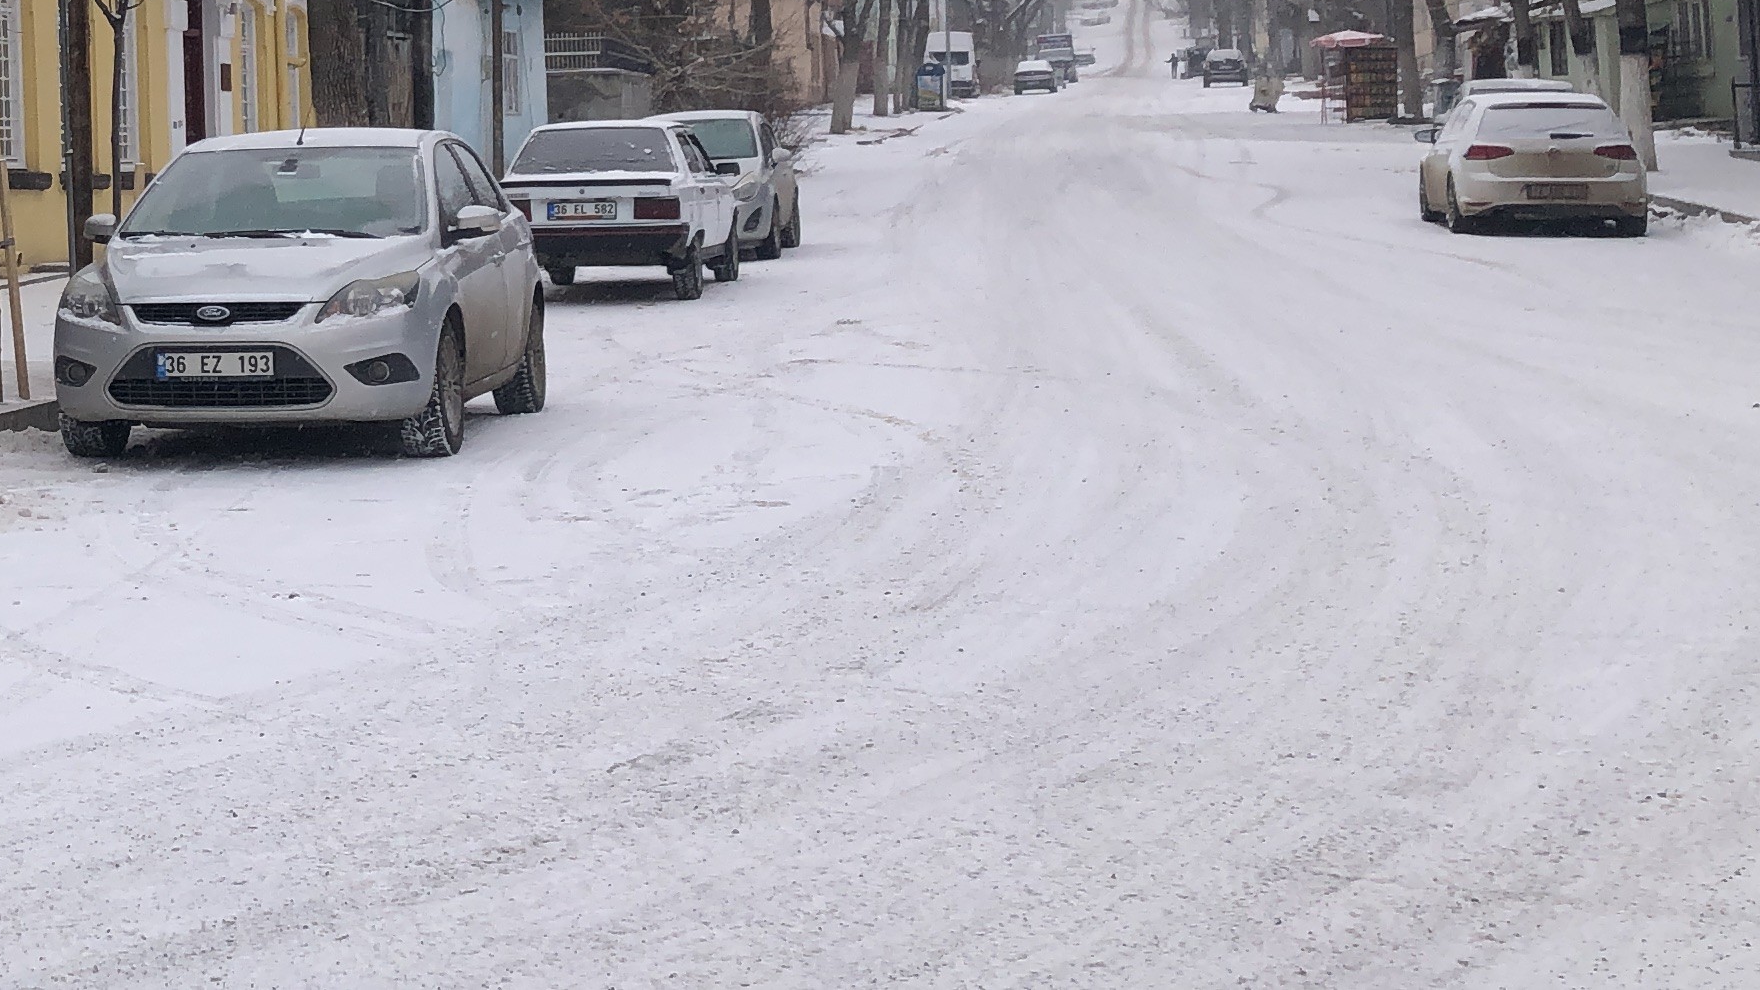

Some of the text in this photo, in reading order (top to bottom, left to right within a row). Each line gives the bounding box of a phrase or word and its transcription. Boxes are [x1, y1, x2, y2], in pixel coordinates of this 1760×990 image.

[554, 204, 567, 214] 36
[594, 203, 614, 214] 582
[166, 355, 270, 373] 36 EZ 193
